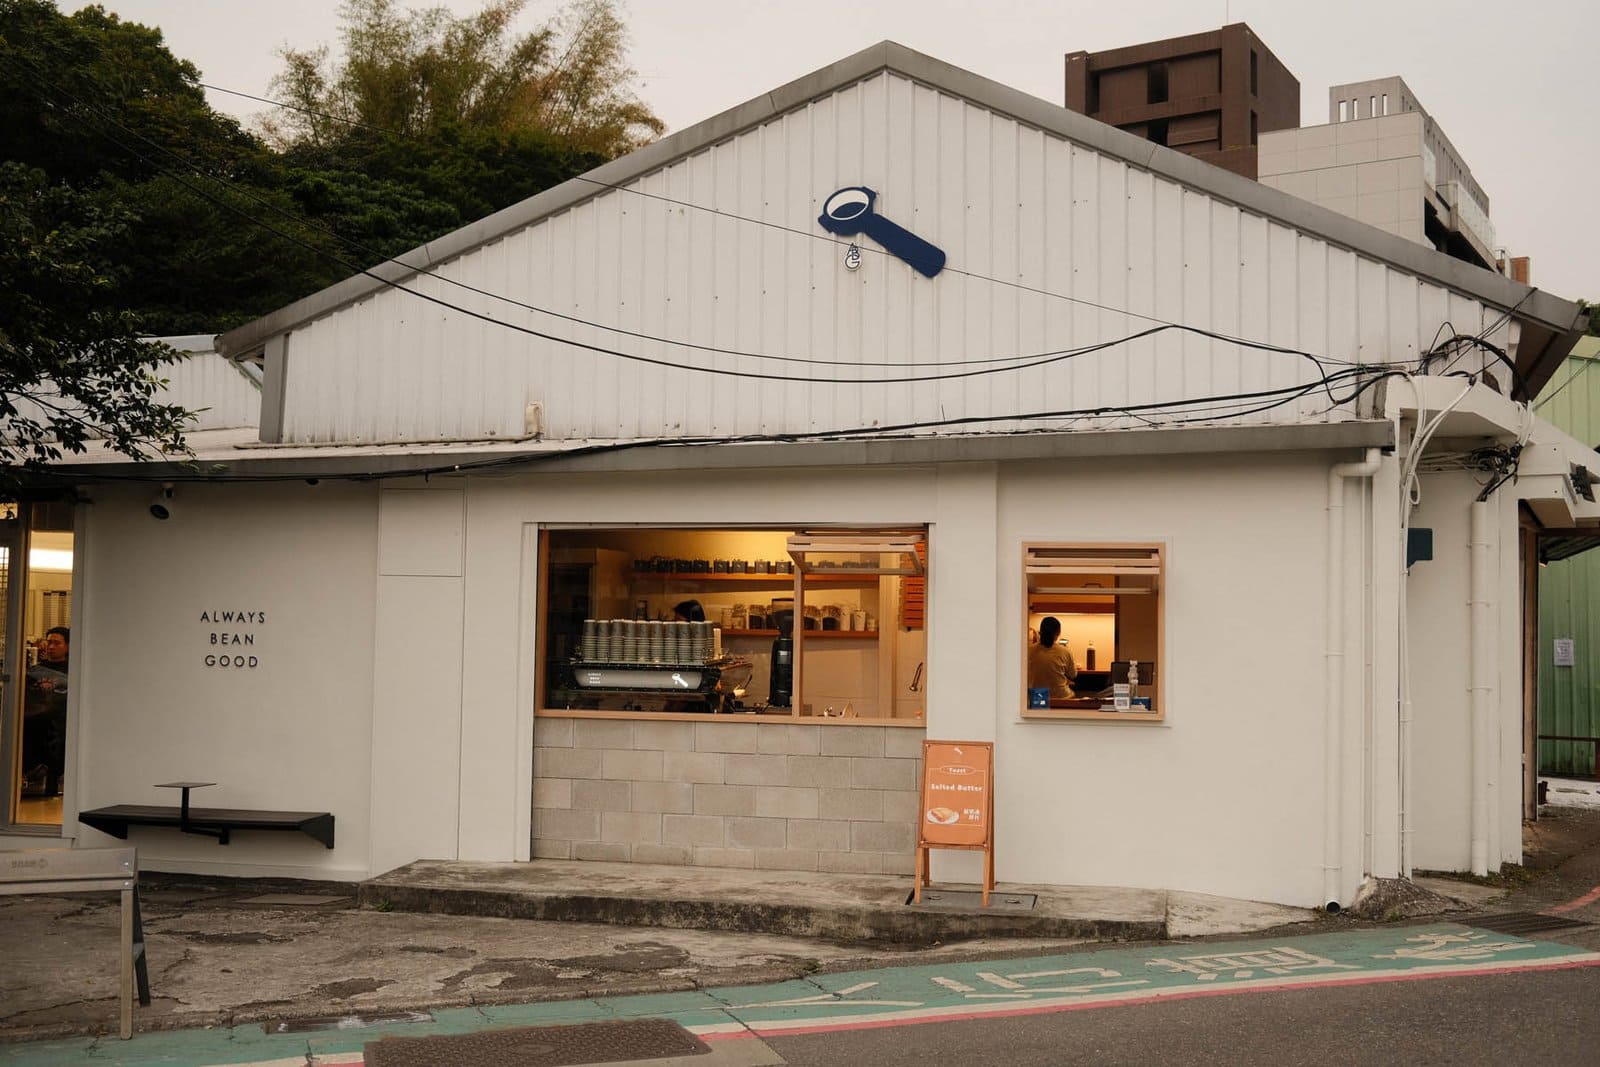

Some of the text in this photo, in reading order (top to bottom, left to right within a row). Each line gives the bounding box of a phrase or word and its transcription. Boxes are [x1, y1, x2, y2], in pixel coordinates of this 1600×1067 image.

[200, 611, 265, 624] ALWAYS
[210, 633, 254, 645] BEAN
[204, 655, 258, 668] GOOD
[931, 783, 983, 792] Salted Butter
[700, 946, 1366, 1010] 人行道
